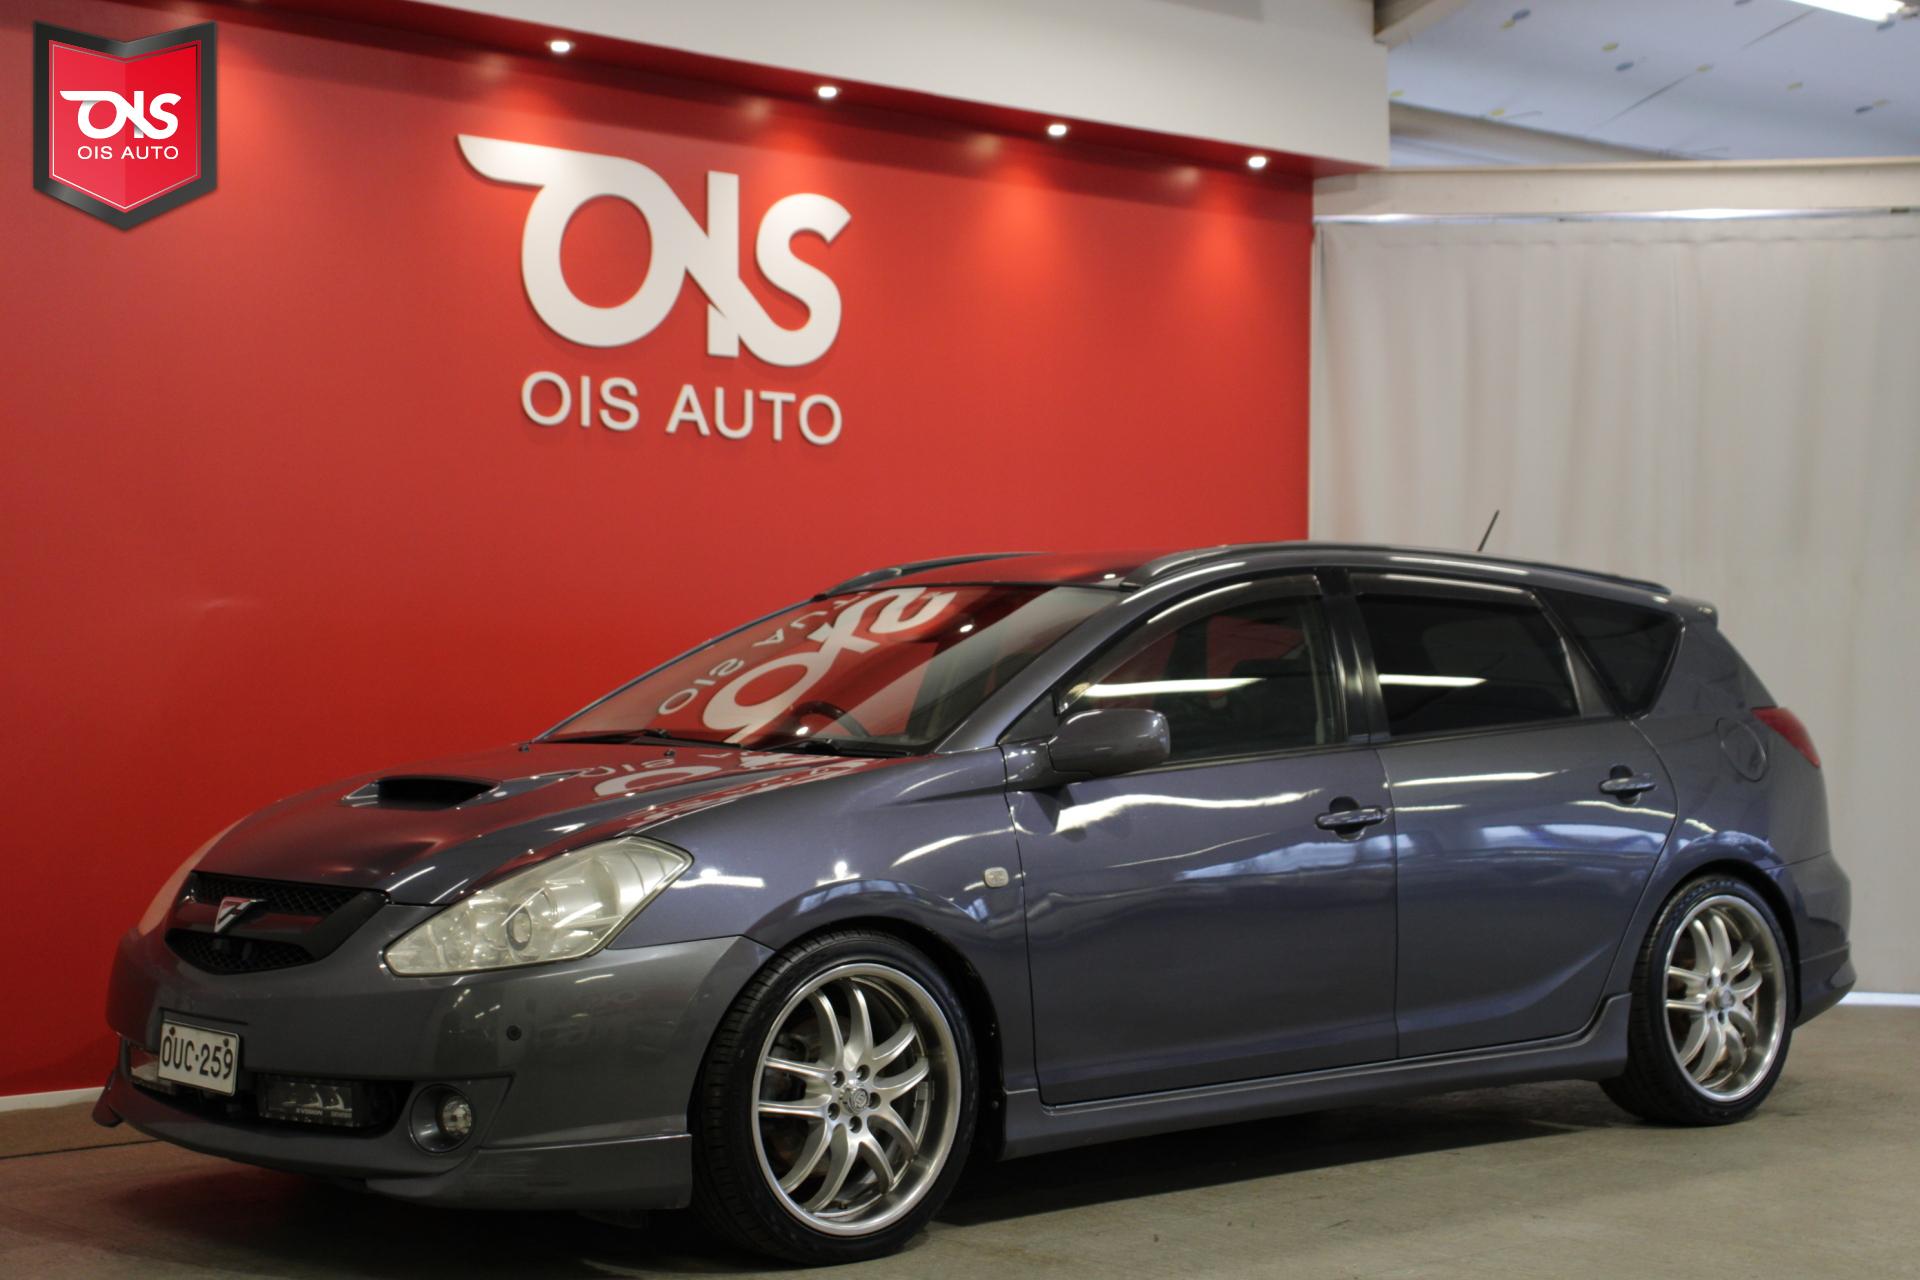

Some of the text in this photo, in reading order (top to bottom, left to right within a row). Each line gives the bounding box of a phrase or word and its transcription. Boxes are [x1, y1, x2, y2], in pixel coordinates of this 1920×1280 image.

[458, 133, 852, 367] OIS
[521, 371, 842, 446] OIS AUTO
